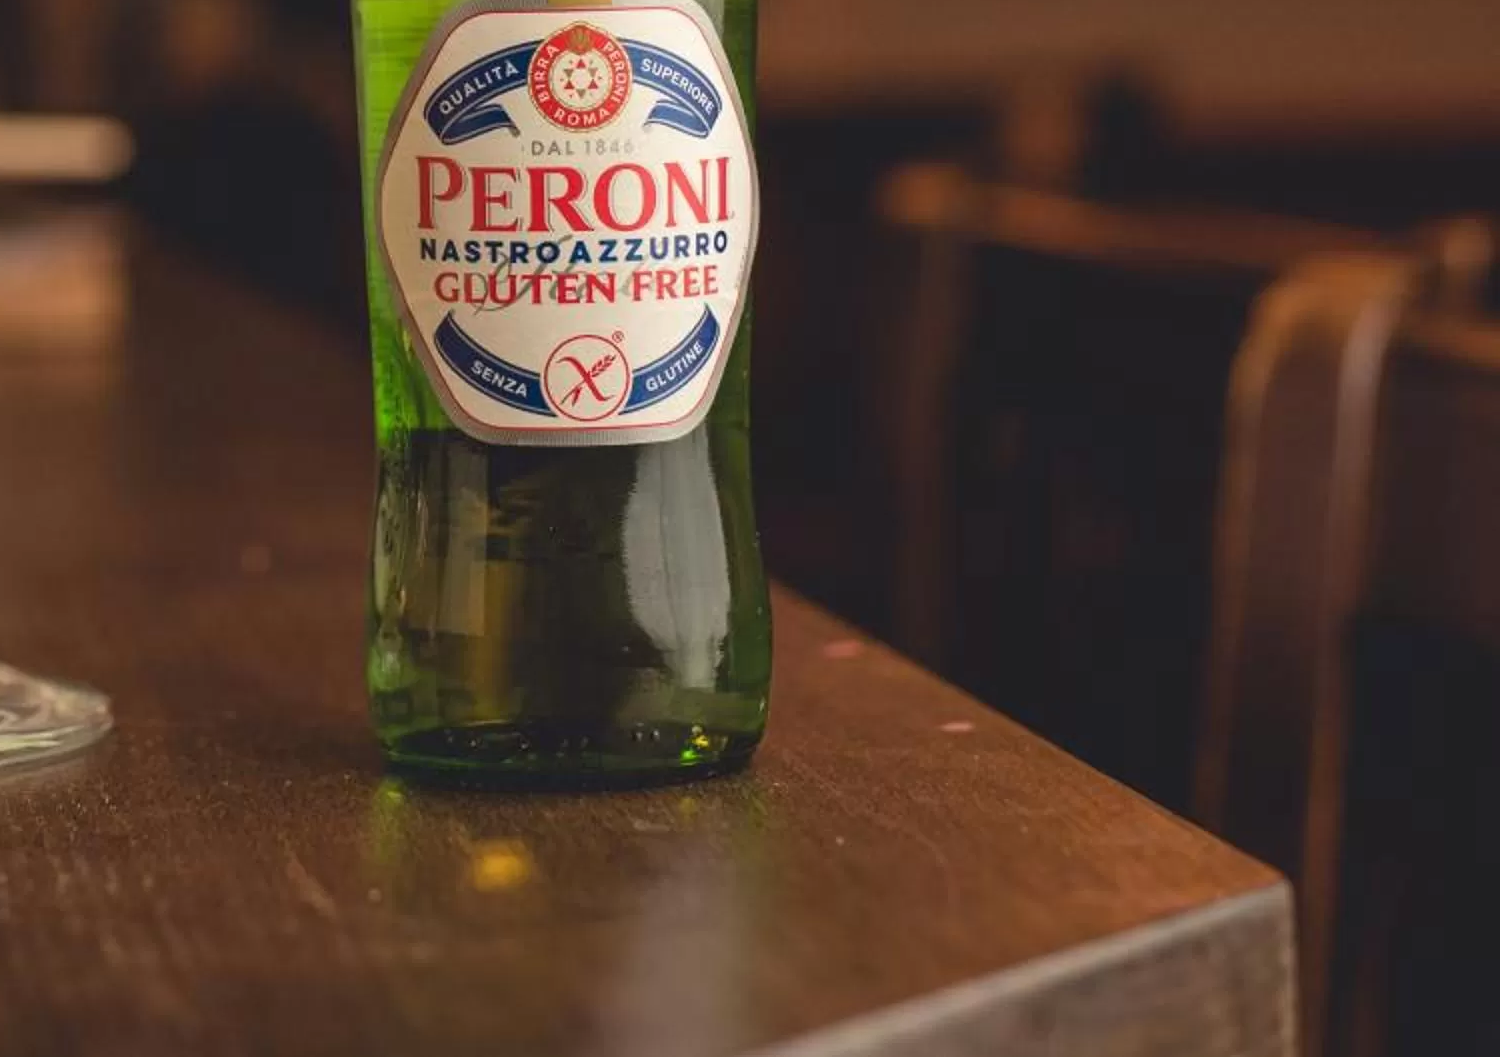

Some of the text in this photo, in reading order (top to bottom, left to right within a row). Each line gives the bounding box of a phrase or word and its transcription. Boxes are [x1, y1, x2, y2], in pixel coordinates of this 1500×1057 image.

[535, 40, 627, 104] BIRRA PERONI
[641, 57, 715, 114] SUPERIORE
[553, 108, 611, 126] ROMA
[532, 139, 634, 156] DAL 1846
[416, 155, 731, 233] PERONI
[435, 264, 719, 305] GLUTEN FREE
[471, 359, 528, 398] SENZA
[645, 340, 704, 392] GLUTINE
